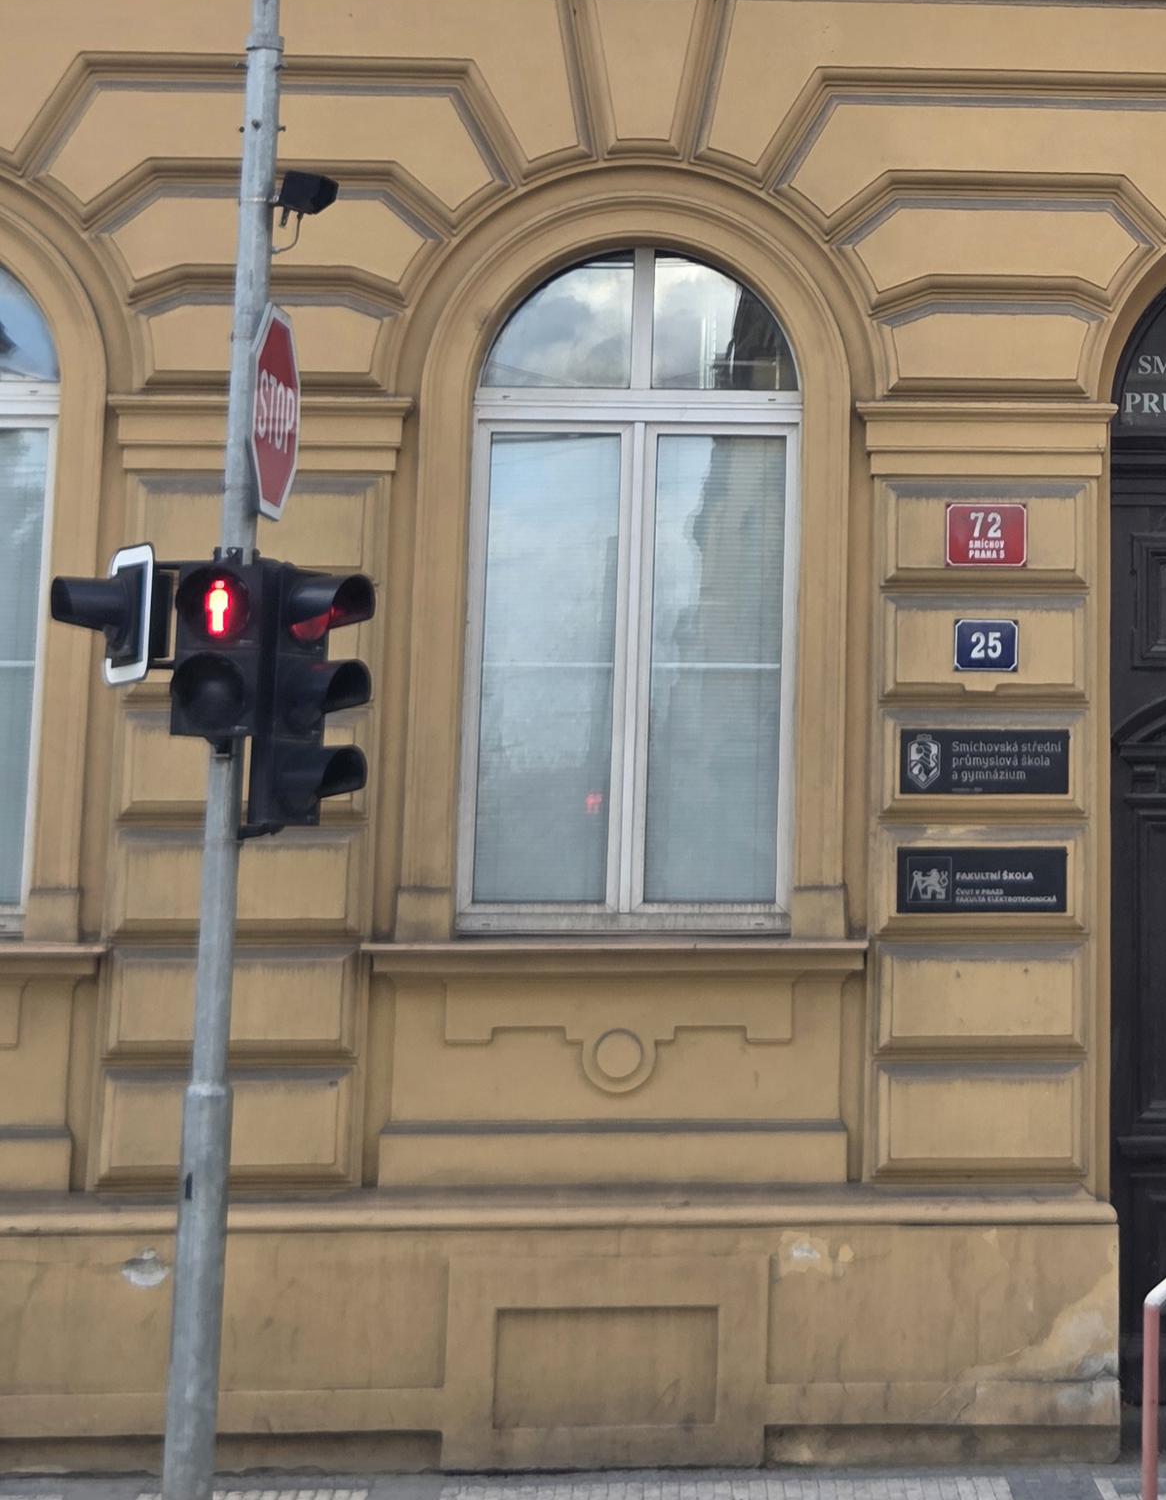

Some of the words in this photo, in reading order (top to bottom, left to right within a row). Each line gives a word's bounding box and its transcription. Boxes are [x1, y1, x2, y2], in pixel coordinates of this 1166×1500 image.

[258, 368, 295, 455] STOP
[969, 511, 1002, 538] 72
[968, 538, 1005, 549] SMÍCHOV
[968, 549, 998, 559] PRAHA
[999, 549, 1005, 559] 5
[970, 631, 1002, 659] 25
[952, 741, 1018, 752] Smíchovská
[1021, 740, 1062, 752] střední
[952, 755, 1018, 768] průmyslová
[1021, 755, 1050, 766] škola
[952, 772, 958, 780] a
[961, 770, 1026, 782] gymnázium
[955, 870, 1000, 880] FAKULTNÍ
[1002, 870, 1034, 880] ŠKOLA
